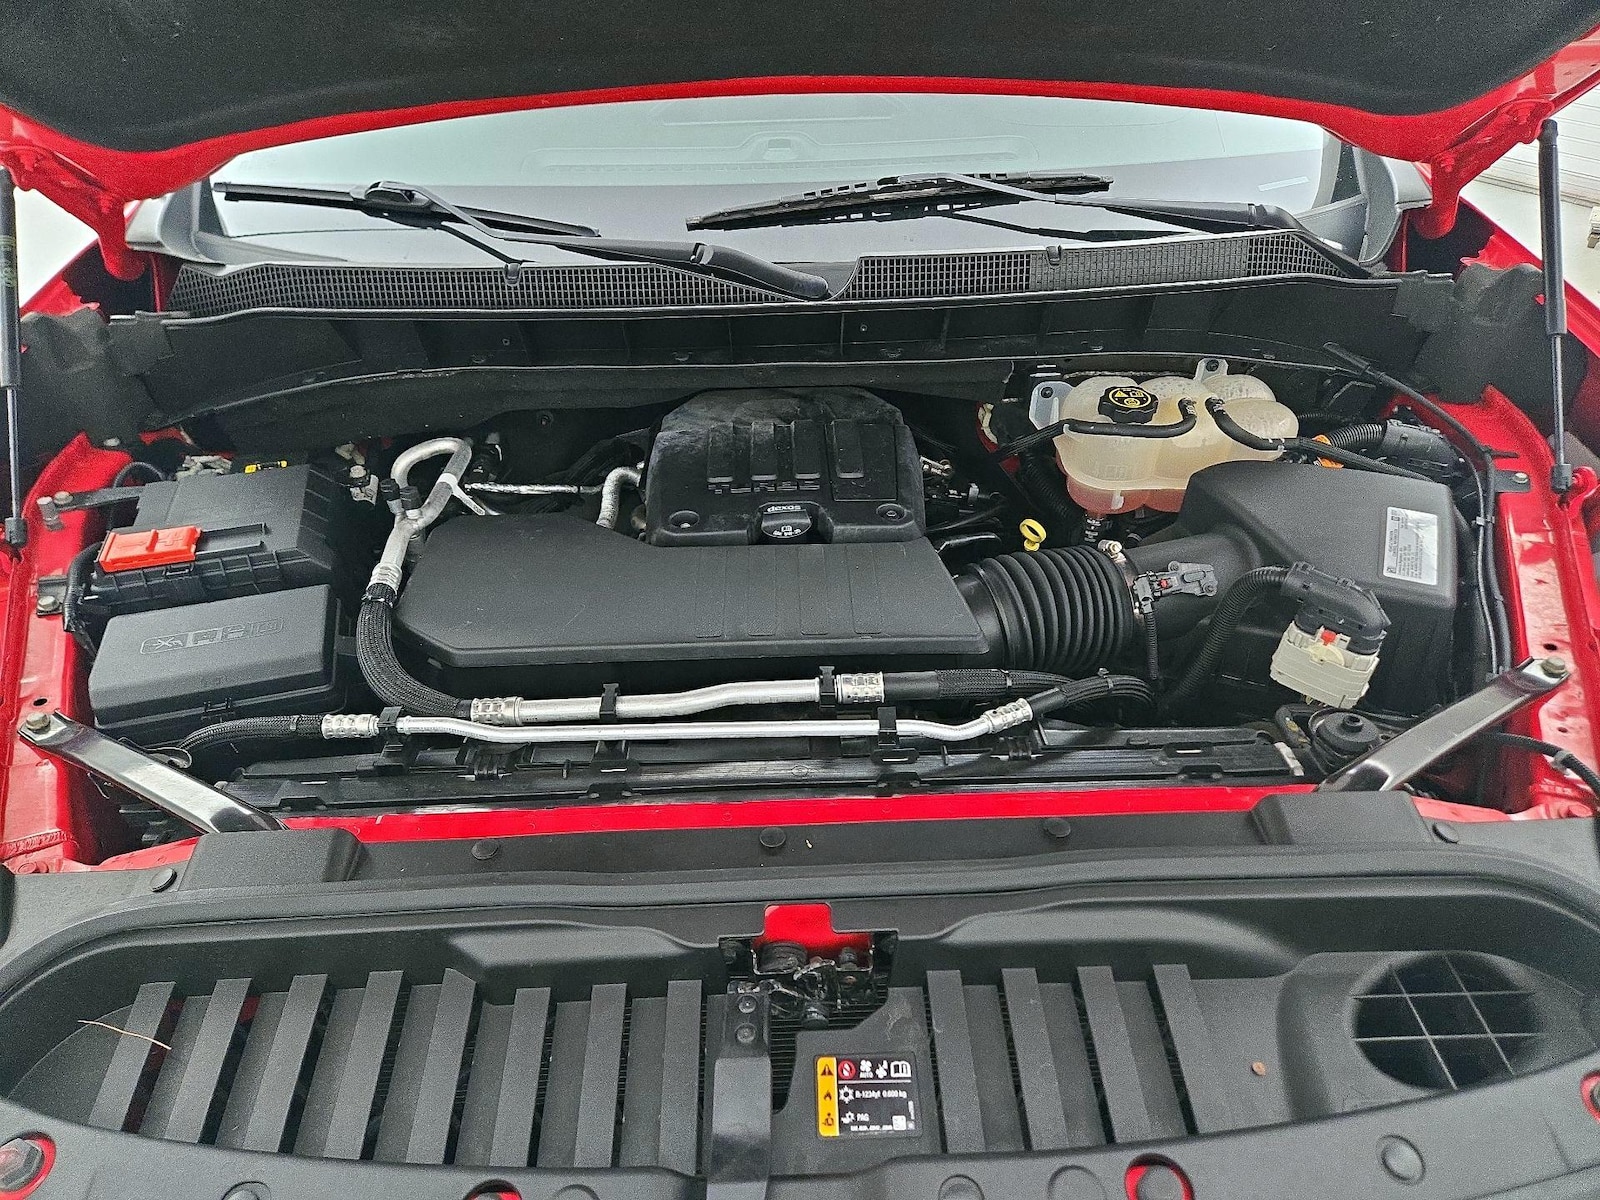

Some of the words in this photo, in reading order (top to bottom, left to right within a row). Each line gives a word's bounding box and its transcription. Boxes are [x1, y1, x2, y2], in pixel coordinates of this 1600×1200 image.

[859, 1071, 874, 1079] AUTO
[855, 1090, 881, 1099] R-1234yf
[899, 1089, 907, 1099] kg
[856, 1112, 870, 1122] PAG
